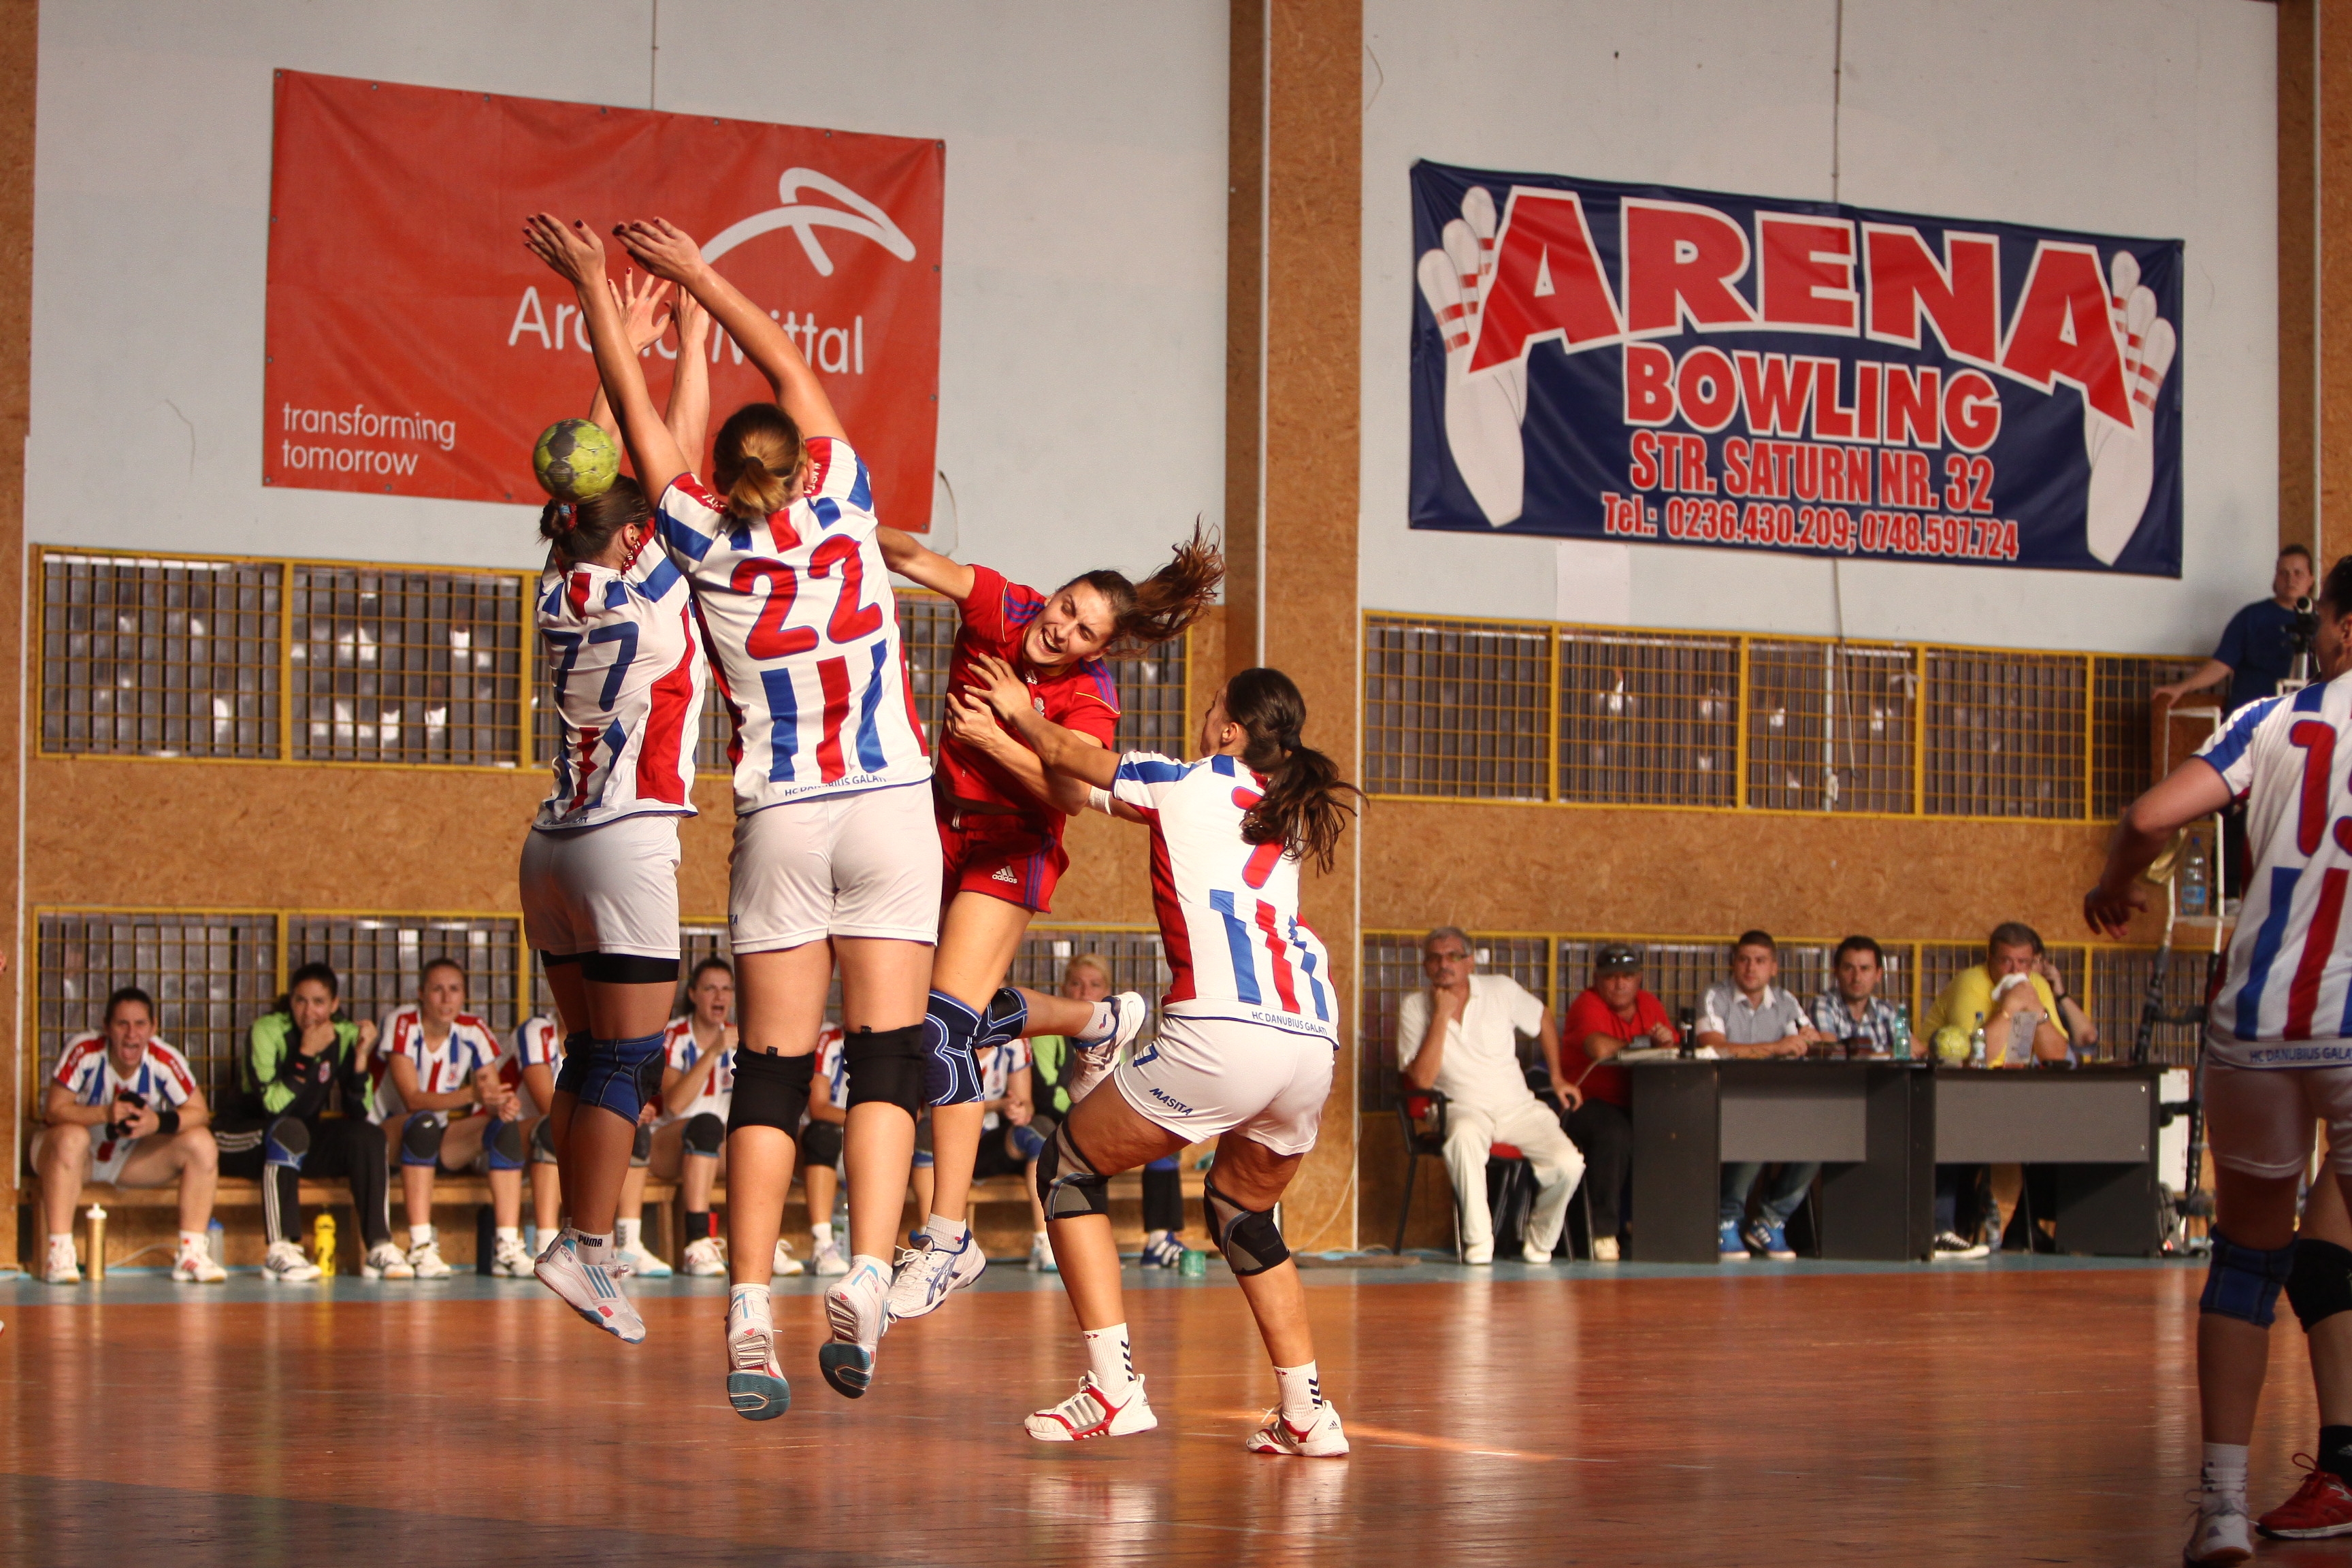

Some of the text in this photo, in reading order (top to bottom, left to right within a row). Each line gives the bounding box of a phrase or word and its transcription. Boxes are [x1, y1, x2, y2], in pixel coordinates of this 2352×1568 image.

[1460, 185, 2142, 439] ARENA
[1623, 343, 2001, 452] BOWLING
[282, 402, 455, 451] transforming
[282, 439, 419, 476] tomorrow
[1629, 431, 1995, 514] STR. SATURN NR. 32
[1601, 491, 2020, 561] Tel.: 0236.430.209; 0748.597.724
[730, 534, 883, 661] 22
[540, 621, 639, 713] 77
[785, 787, 798, 796] HC
[992, 873, 1017, 884] adidas
[1252, 1011, 1264, 1021] HC
[1264, 1013, 1303, 1030] DANUBIUS
[2250, 1050, 2264, 1062] HC
[2266, 1047, 2320, 1062] DANUBIUS
[1149, 1088, 1194, 1116] MASITA
[578, 1234, 603, 1247] PUMA
